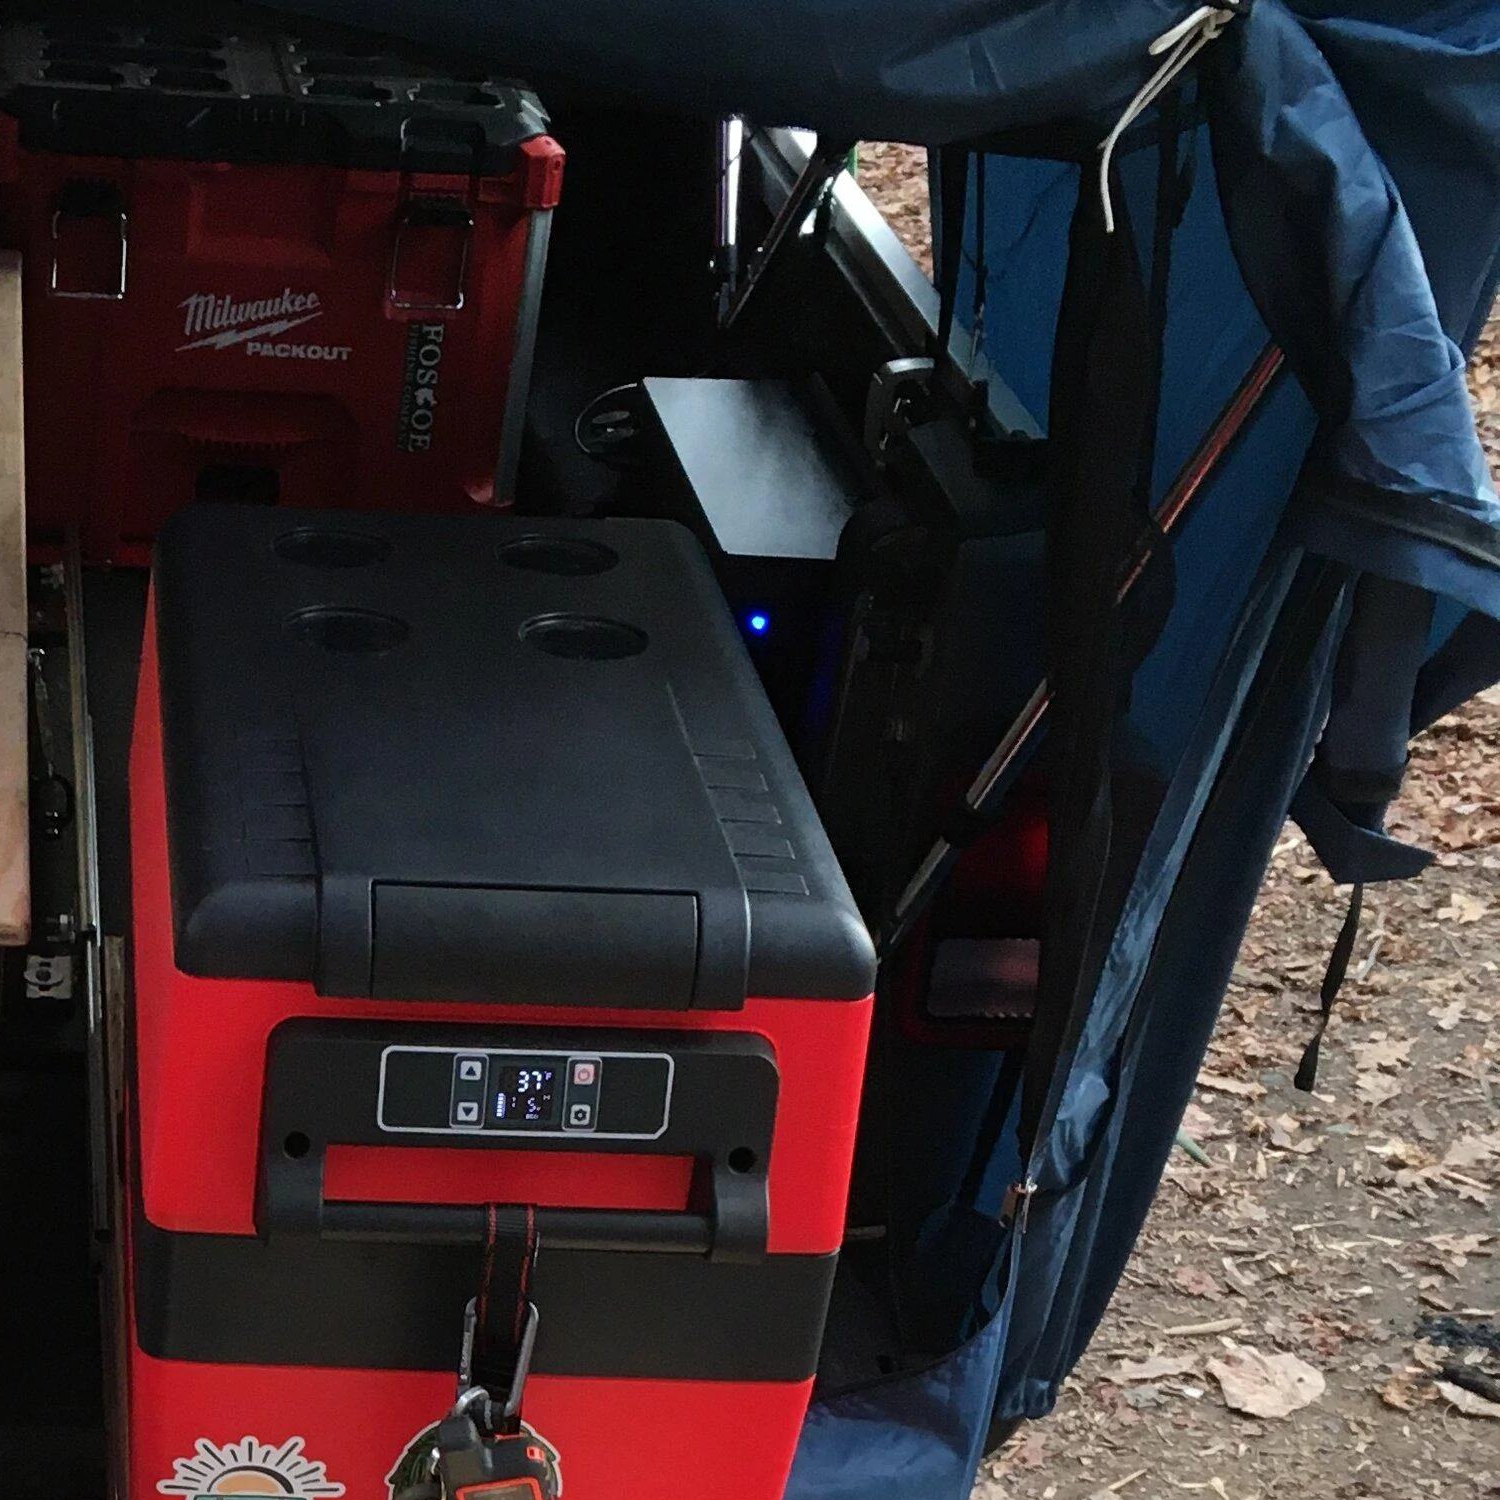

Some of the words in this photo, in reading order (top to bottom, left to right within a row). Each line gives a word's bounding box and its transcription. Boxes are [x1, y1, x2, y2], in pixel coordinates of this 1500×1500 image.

[177, 288, 322, 336] Milwaukee
[245, 342, 352, 361] PACKOUT
[518, 1070, 542, 1093] 37
